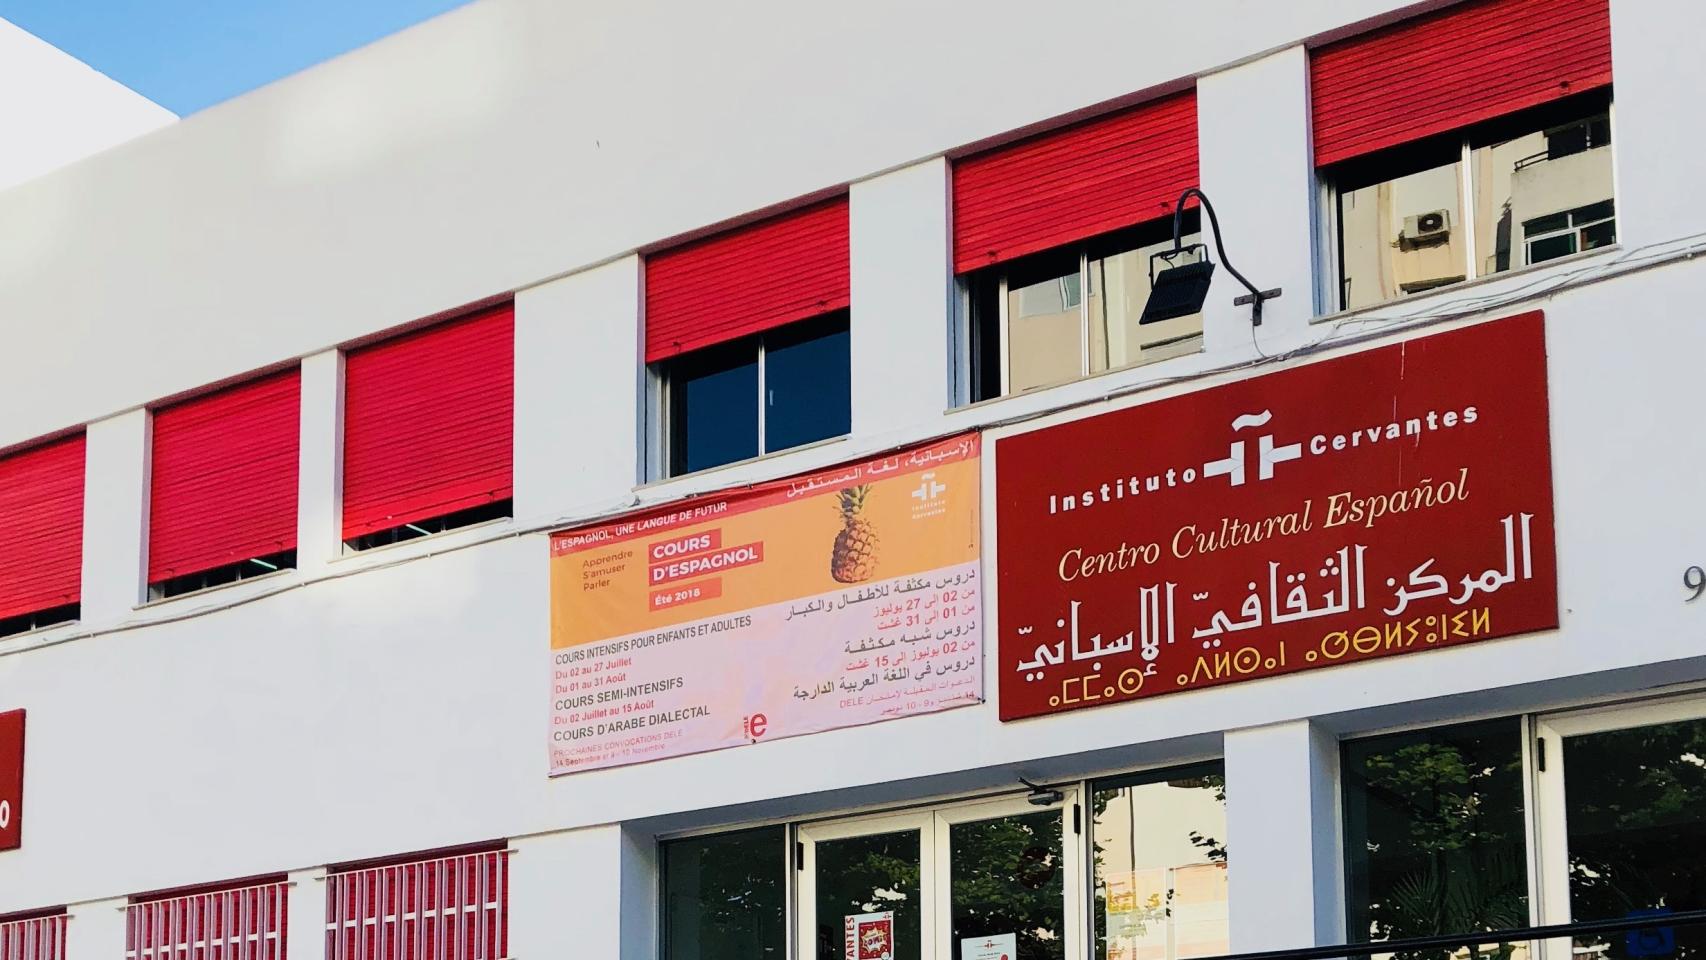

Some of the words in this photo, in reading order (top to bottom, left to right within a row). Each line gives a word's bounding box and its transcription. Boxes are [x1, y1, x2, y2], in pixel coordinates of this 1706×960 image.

[866, 458, 899, 475] لغة
[1050, 468, 1196, 514] Instituto
[1309, 406, 1478, 455] Cervantes
[786, 468, 862, 498] المستقبل
[553, 529, 614, 551] L'ESPAGNOL,
[615, 524, 635, 536] UNE
[637, 515, 677, 530] LANGUE
[679, 511, 692, 521] DE
[695, 501, 728, 518] FUTUR
[1058, 542, 1160, 582] Centro
[1172, 500, 1313, 559] Cultural
[1322, 467, 1470, 529] Español
[653, 534, 711, 560] COURS
[582, 549, 634, 570] Apprendre
[653, 546, 759, 582] D'ESPAGNOL
[1382, 511, 1535, 617] المركز
[583, 564, 626, 581] S'amuser
[936, 569, 976, 589] دروس
[583, 578, 611, 592] Parler
[893, 577, 932, 594] مكثفة
[1683, 565, 1706, 603] 9
[655, 594, 673, 607] Été
[674, 587, 701, 601] 2018
[906, 598, 921, 611] 27
[943, 589, 958, 603] 02
[961, 589, 976, 600] من
[785, 600, 834, 621] والكبار
[872, 606, 904, 620] يوليوز
[906, 614, 921, 627] 31
[943, 607, 957, 619] 01
[961, 605, 976, 617] من
[877, 616, 902, 632] غشت
[936, 621, 976, 641] دروس
[555, 650, 585, 665] COURS
[586, 641, 629, 659] INTENSIFS
[631, 635, 655, 650] POUR
[657, 626, 696, 645] ENFANTS
[698, 624, 710, 636] ET
[711, 615, 752, 633] ADULTES
[900, 627, 932, 644] شبه
[844, 637, 896, 655] مكثفة
[943, 641, 958, 655] 02
[961, 640, 976, 652] من
[555, 671, 568, 680] Du
[569, 667, 579, 677] 02
[582, 666, 592, 675] au
[594, 661, 603, 672] 27
[606, 657, 632, 670] Juillet
[845, 659, 870, 673] غشت
[875, 655, 889, 668] 15
[936, 656, 976, 676] دروس
[555, 684, 568, 694] Du
[569, 681, 580, 692] 01
[582, 680, 592, 690] au
[594, 677, 604, 687] 31
[605, 671, 627, 684] Août
[839, 672, 878, 693] العربية
[883, 667, 910, 682] اللغة
[914, 663, 932, 682] في
[555, 694, 594, 711] COURS
[596, 676, 684, 701] SEMI-INTENSIFS
[793, 680, 835, 702] الدارجة
[554, 716, 568, 725] Du
[569, 712, 580, 724] 02
[582, 707, 607, 721] Juillet
[609, 708, 620, 716] au
[622, 703, 633, 713] 15
[634, 699, 655, 710] Août
[839, 696, 865, 709] DELE
[553, 726, 594, 742] COURS
[596, 717, 646, 735] D'ARABE
[649, 704, 711, 726] DIALECTAL
[846, 917, 855, 960] ANTES
